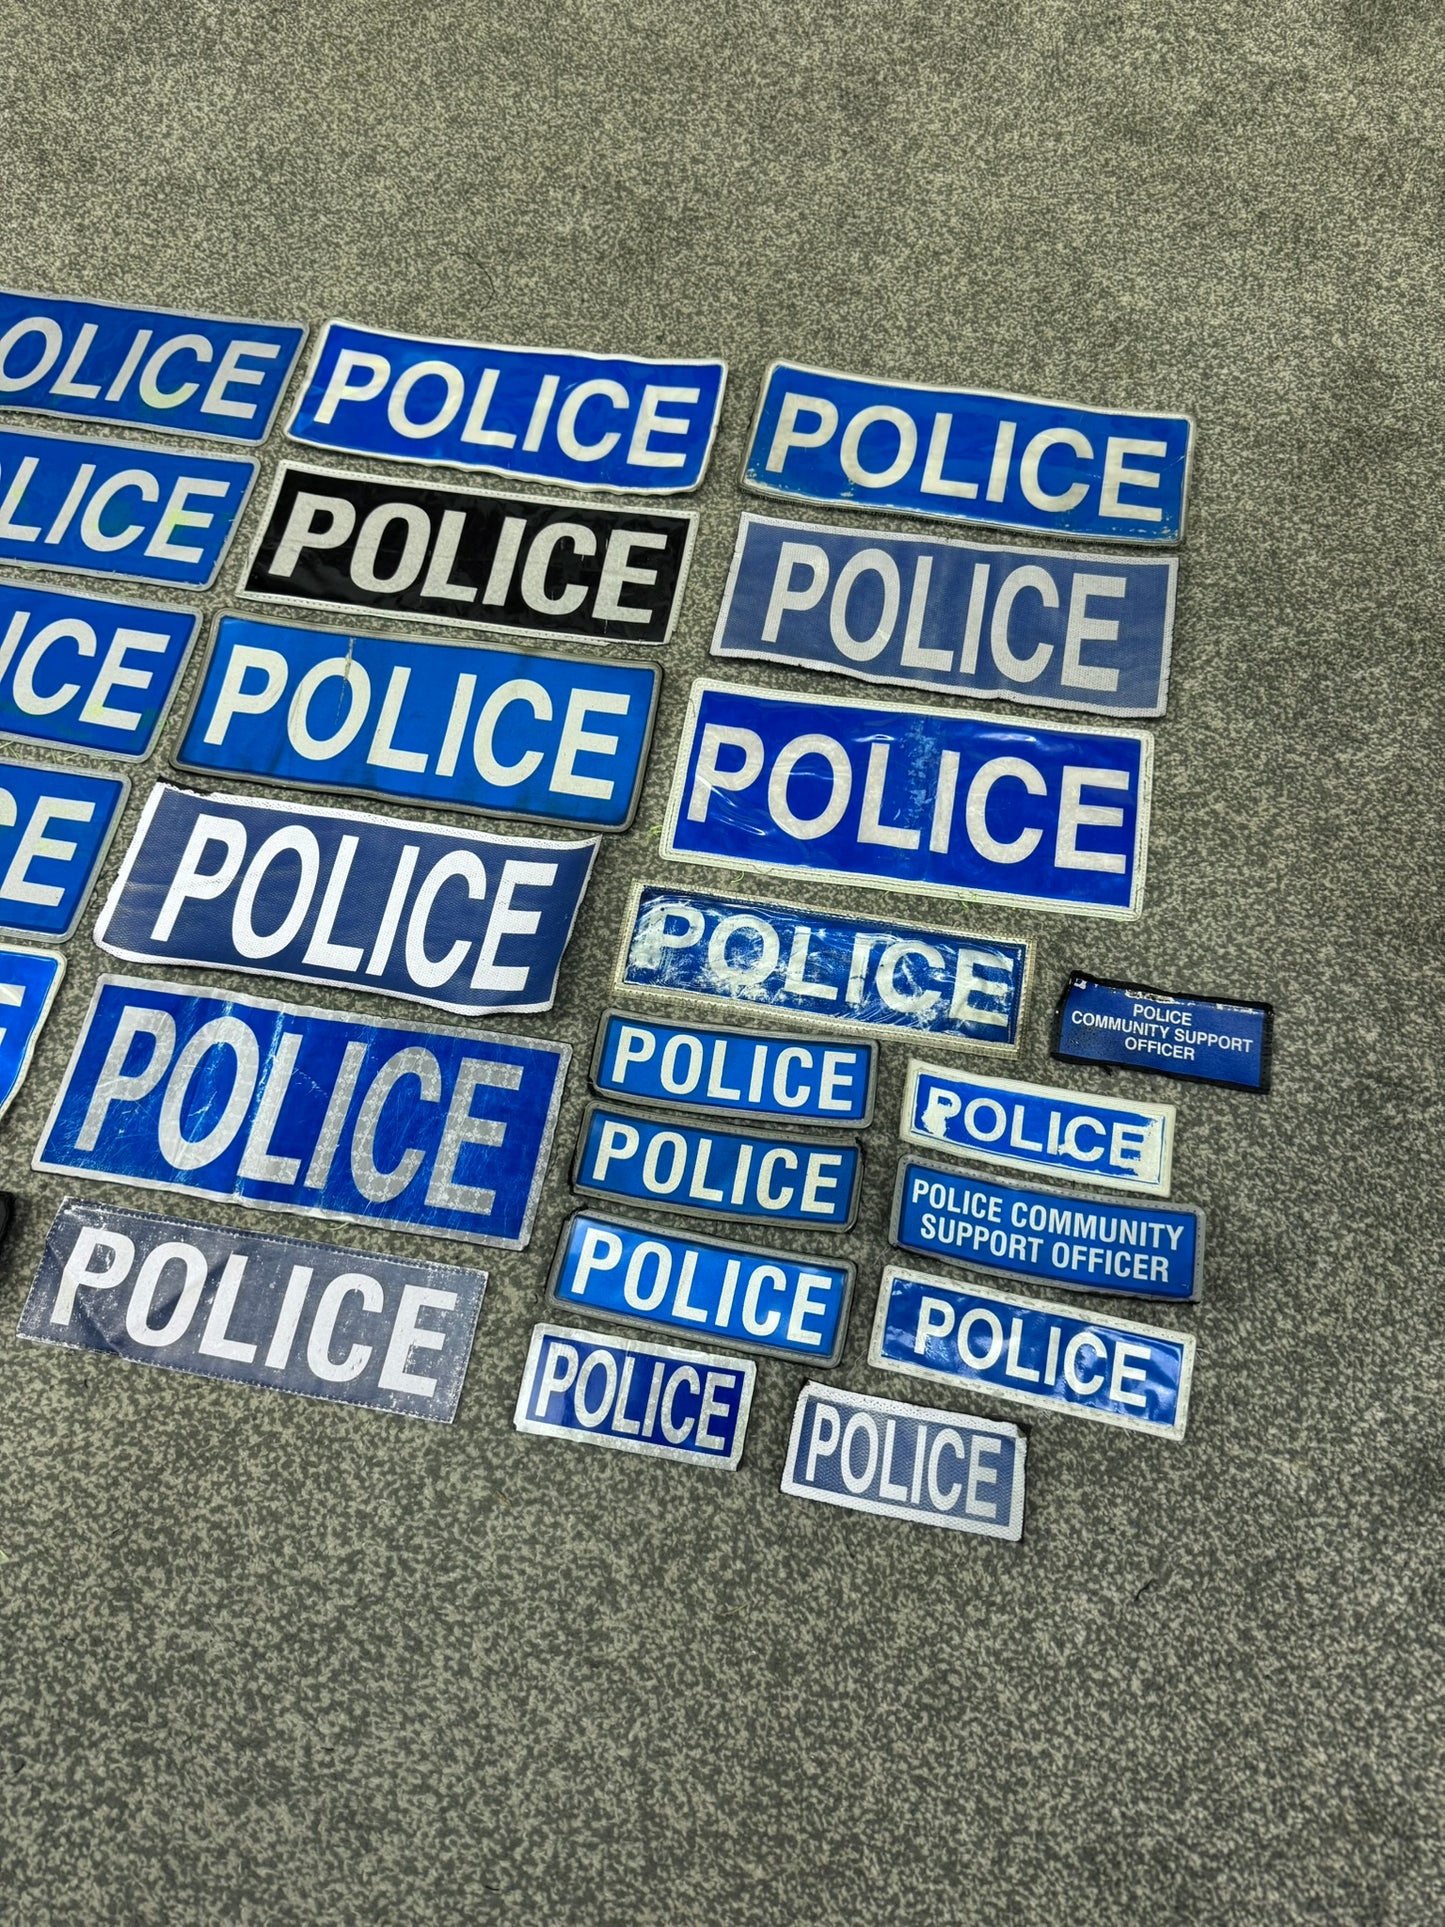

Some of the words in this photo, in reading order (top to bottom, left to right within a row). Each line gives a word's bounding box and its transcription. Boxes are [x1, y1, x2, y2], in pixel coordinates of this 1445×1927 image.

[313, 348, 701, 469] POLICE
[765, 391, 1168, 523] POLICE
[0, 455, 231, 564] LICE
[267, 491, 669, 625] POLICE
[760, 541, 1127, 692] POLICE
[203, 644, 631, 801] POLICE
[686, 722, 1130, 875] POLICE
[149, 812, 559, 992] POLICE
[630, 901, 1015, 1028] POLICE
[1133, 1003, 1193, 1027] POLICE
[611, 1025, 857, 1112] POLICE
[1071, 1010, 1170, 1040] COMMUNITY
[1174, 1028, 1254, 1053] SUPPORT
[1124, 1036, 1196, 1061] OFFICER
[73, 1005, 524, 1217] POLICE
[592, 1119, 843, 1215] POLICE
[924, 1085, 1160, 1174] POLICE
[911, 1178, 1003, 1224] POLICE
[1010, 1202, 1185, 1252] COMMUNITY
[919, 1213, 1045, 1264] SUPPORT
[1051, 1240, 1170, 1283] OFFICER
[50, 1224, 459, 1398] POLICE
[571, 1227, 832, 1347] POLICE
[536, 1341, 736, 1450] POLICE
[914, 1297, 1151, 1405] POLICE
[806, 1404, 998, 1518] POLICE
